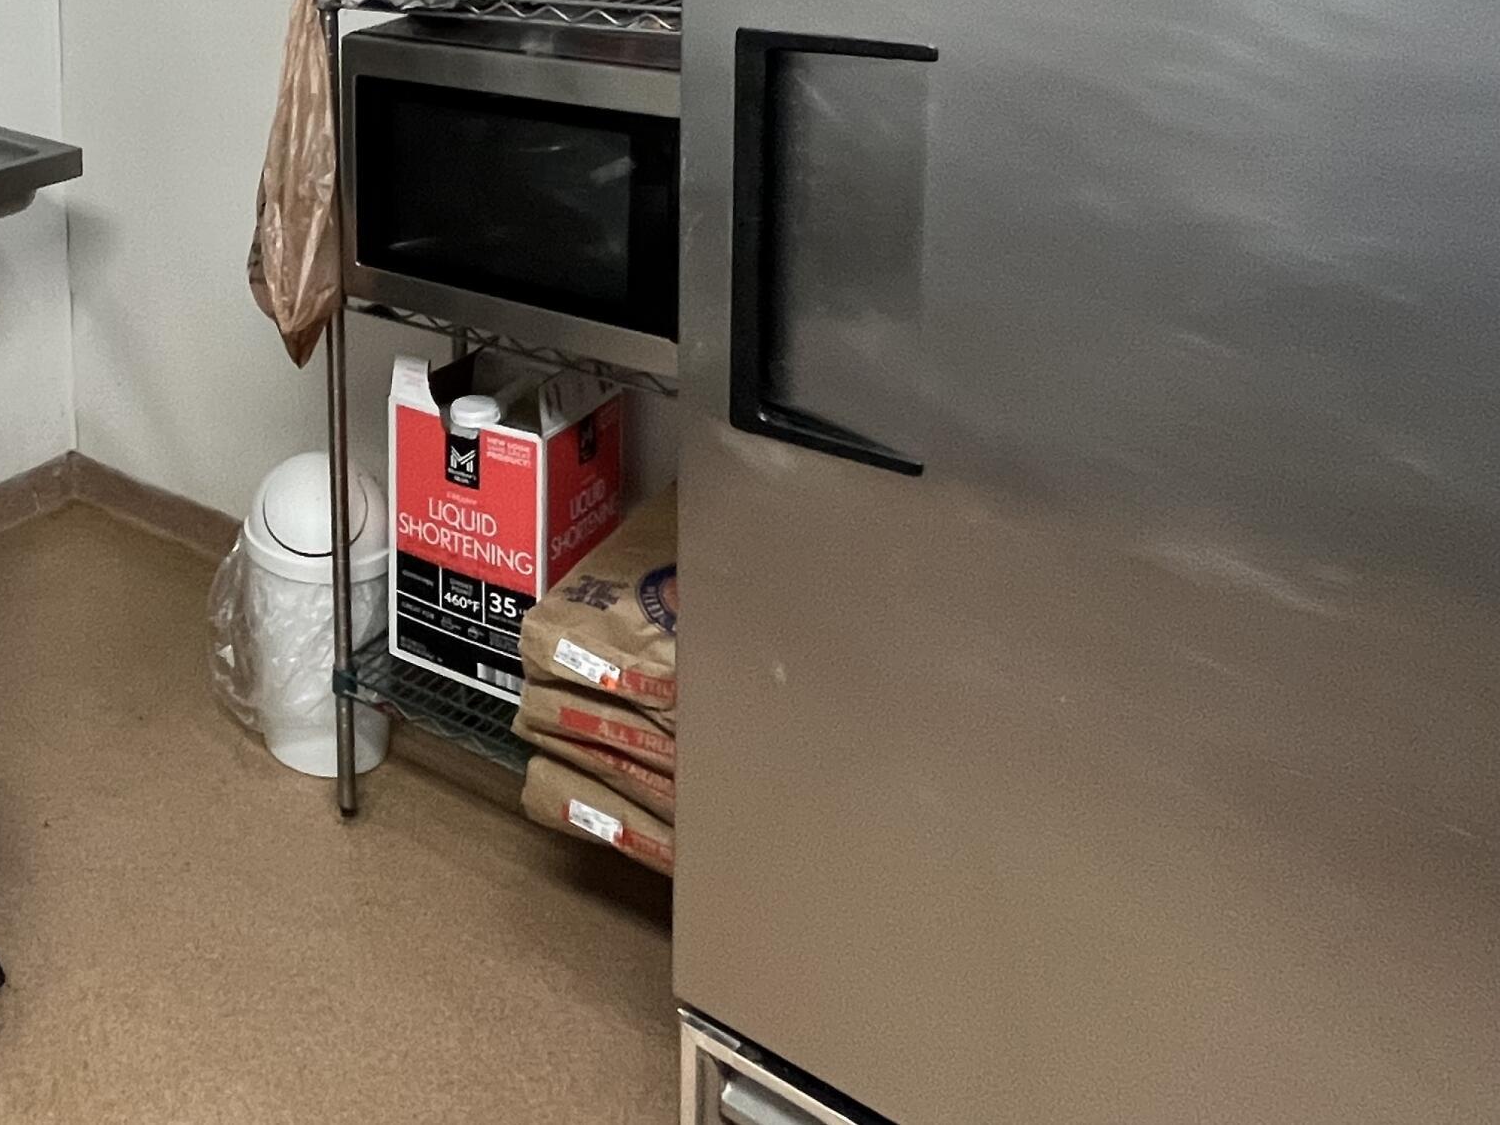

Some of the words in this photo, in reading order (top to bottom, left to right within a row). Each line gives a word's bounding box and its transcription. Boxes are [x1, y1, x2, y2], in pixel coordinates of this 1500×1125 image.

[428, 497, 497, 537] LIQUID
[398, 512, 533, 576] SHORTENING
[489, 592, 517, 619] 35
